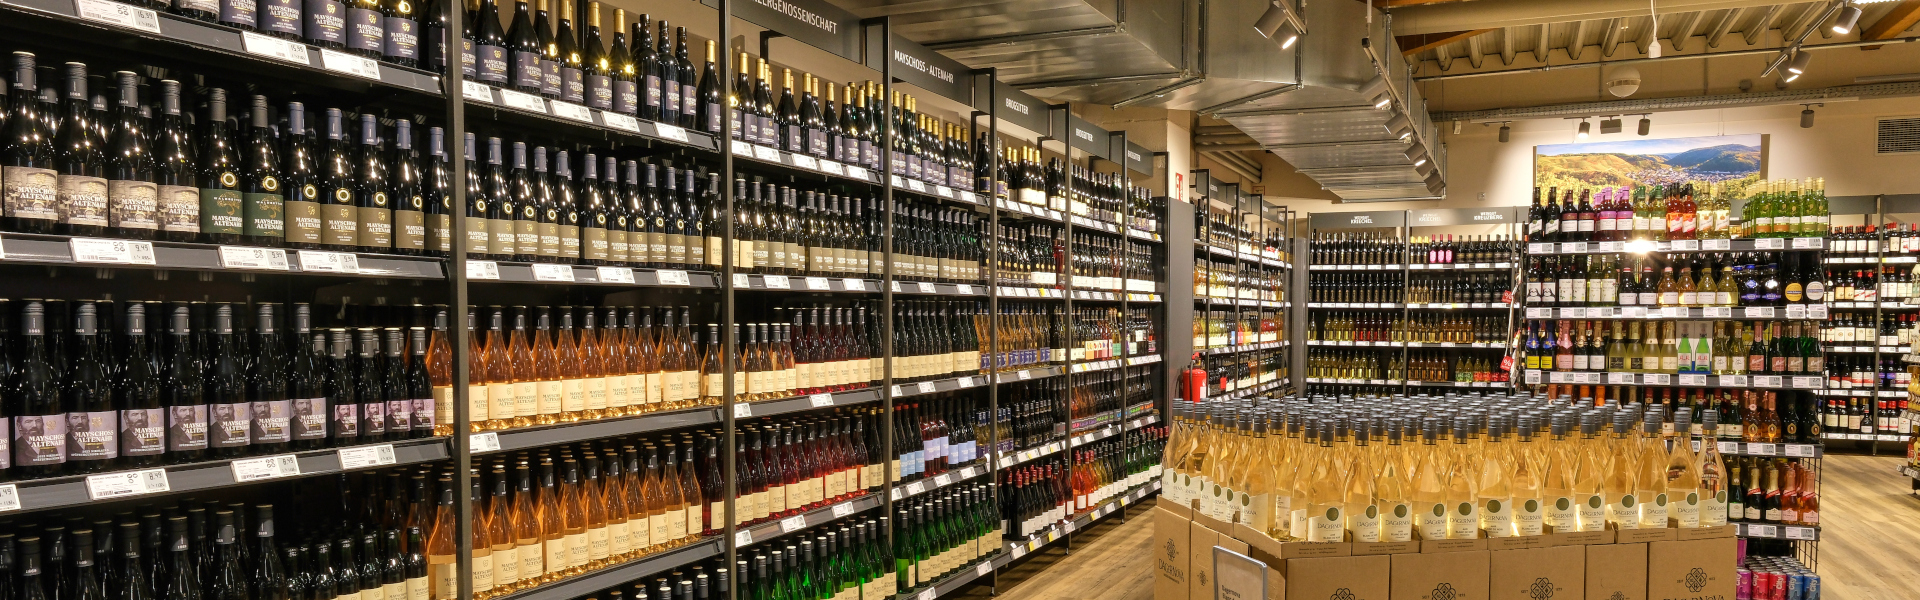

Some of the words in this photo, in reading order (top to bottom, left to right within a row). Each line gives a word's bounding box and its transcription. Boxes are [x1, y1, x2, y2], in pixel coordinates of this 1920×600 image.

[752, 0, 836, 34] ERGENOSSENSCHAFT
[894, 50, 925, 72] MAYSCHOSS
[929, 65, 953, 83] ALTENAHR
[1006, 98, 1028, 115] BROGSITTER
[1222, 585, 1240, 598] Dagernova
